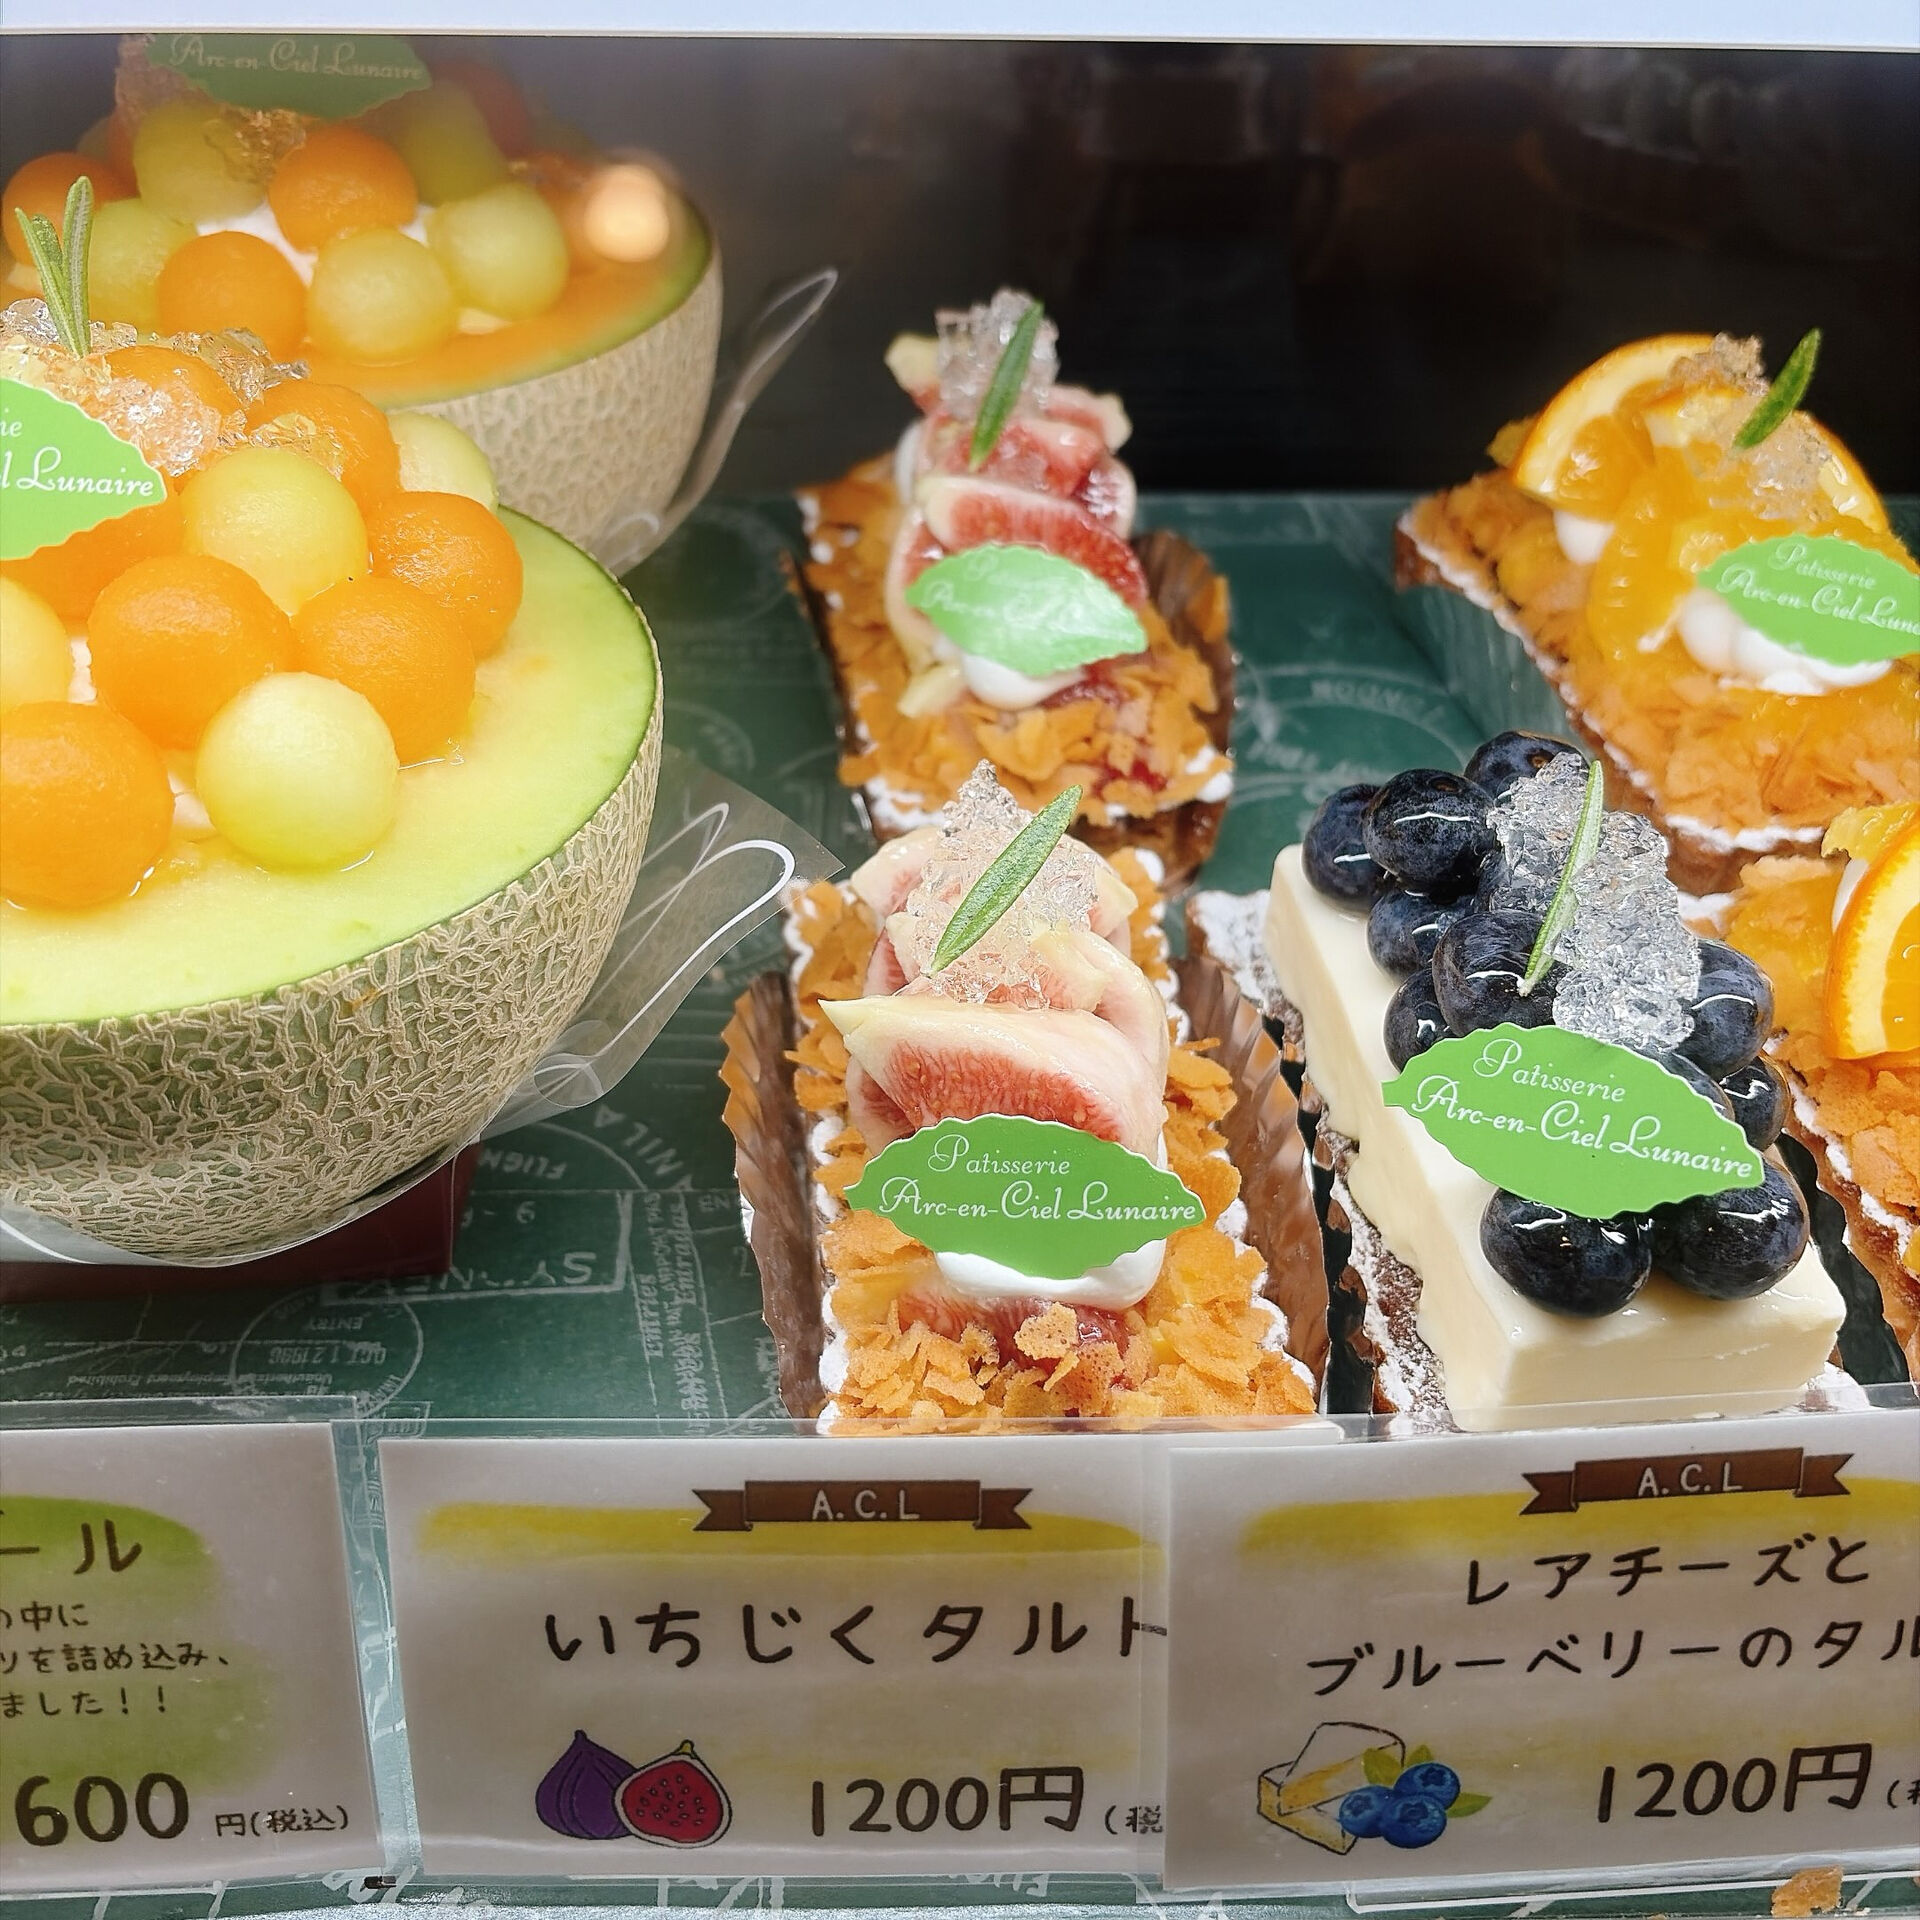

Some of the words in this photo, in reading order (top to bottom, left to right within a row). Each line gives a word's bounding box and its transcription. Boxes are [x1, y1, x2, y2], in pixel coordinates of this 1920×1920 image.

[16, 446, 154, 497] Lunaire
[1716, 562, 1863, 621] Arc-en-Ciel
[1768, 540, 1877, 590] Patisserie
[1472, 1038, 1626, 1103] Patisserie
[927, 1134, 1071, 1175] Patisserie
[1411, 1075, 1612, 1150] Arc-en-Ciel
[1608, 1115, 1754, 1178] Lunaire
[879, 1177, 1062, 1220] Arc-en-Ciel
[1066, 1181, 1197, 1220] Lunaire
[812, 1489, 920, 1523] A.C.L
[1638, 1462, 1744, 1498] A.C.L
[0, 1510, 142, 1574] ール
[1466, 1532, 1870, 1606] レアチーズと
[545, 1597, 1168, 1668] いちじくタルト
[14, 1772, 190, 1846] 600
[811, 1766, 1085, 1837] 1200円
[1598, 1742, 1873, 1824] 1200円
